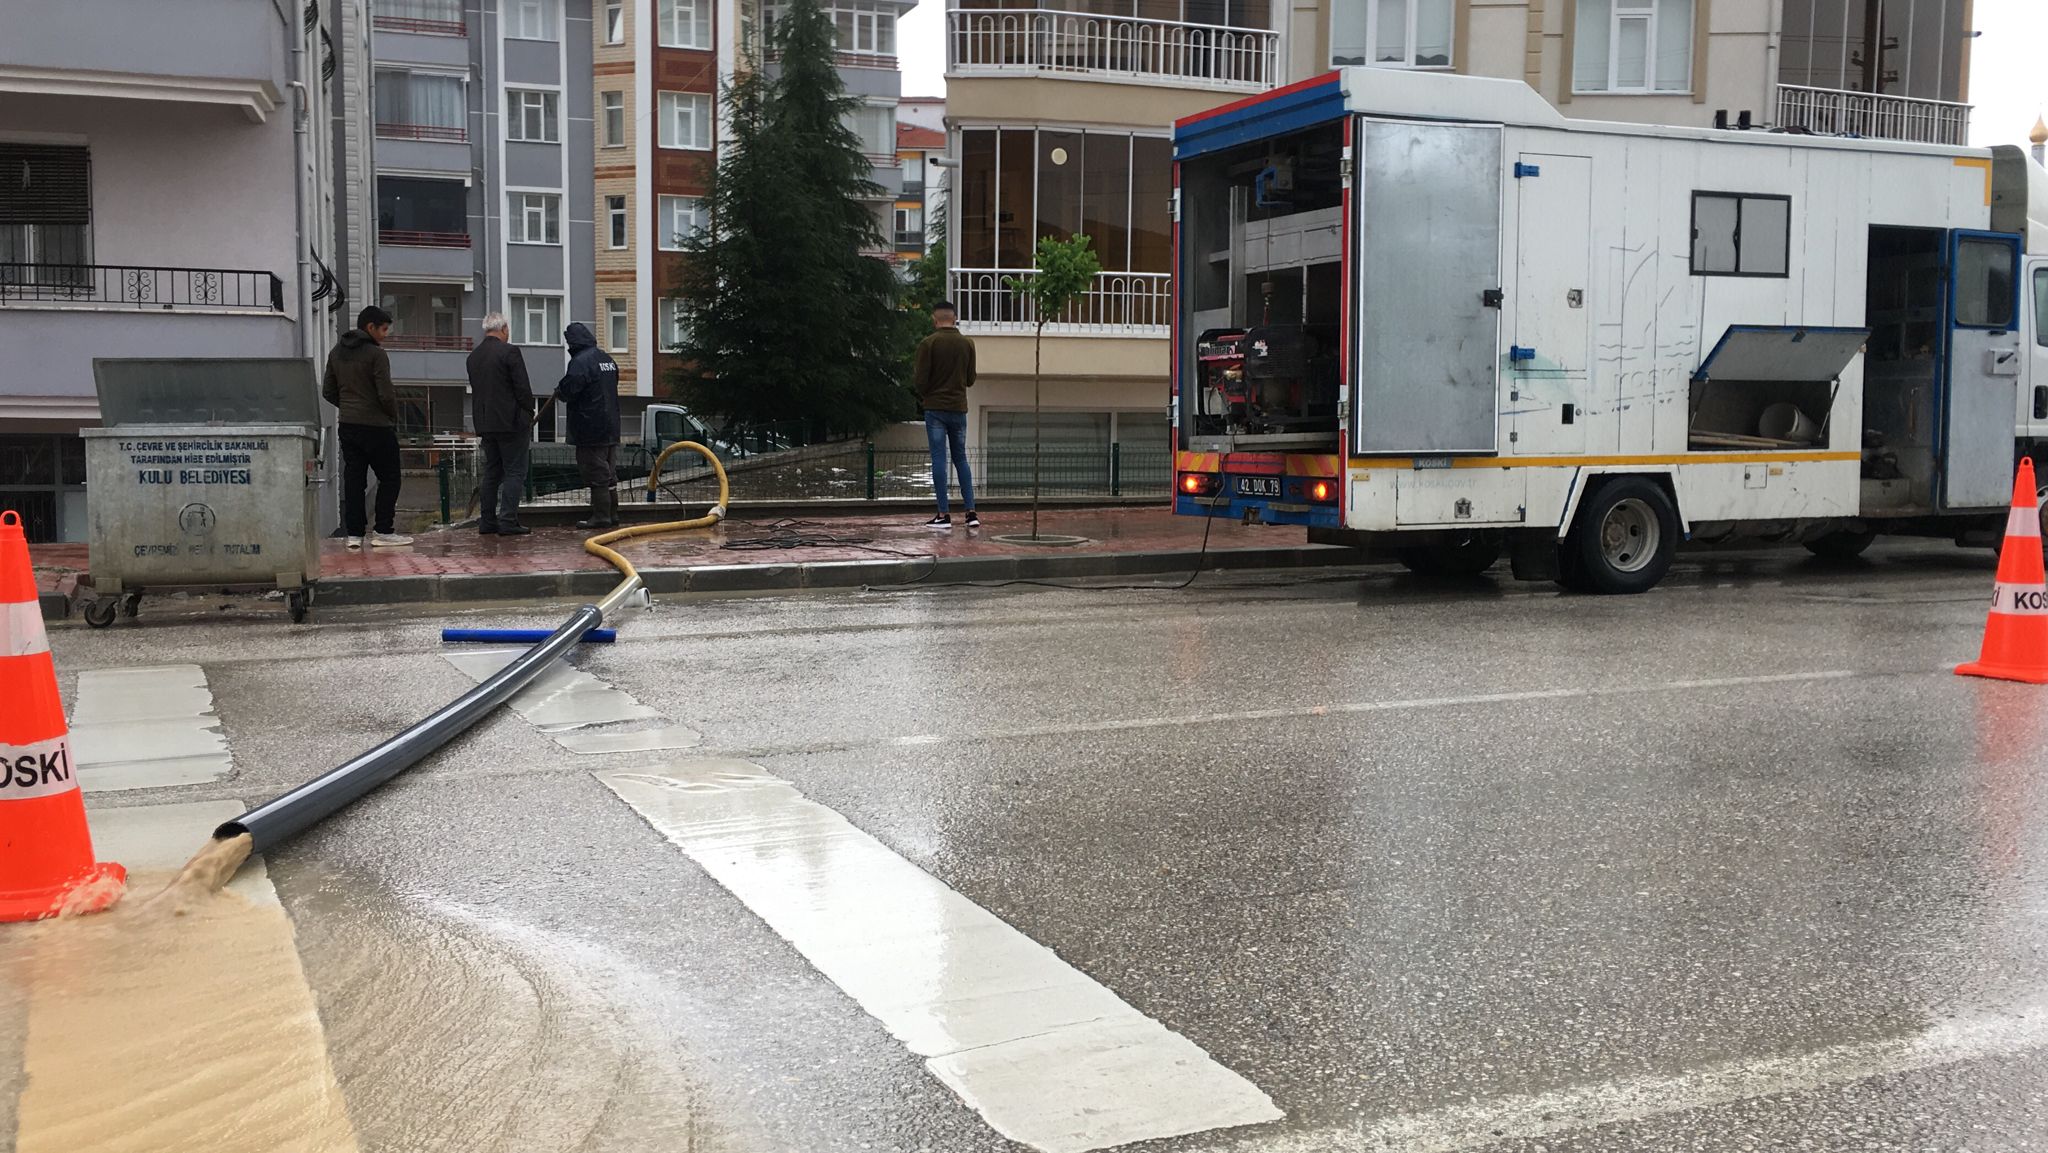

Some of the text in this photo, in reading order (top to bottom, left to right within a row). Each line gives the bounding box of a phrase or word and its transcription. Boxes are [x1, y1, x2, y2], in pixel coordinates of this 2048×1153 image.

[136, 442, 163, 454] ÇEVRE
[165, 442, 176, 451] VE
[177, 440, 223, 453] ŞEHİRCİLİK
[225, 440, 269, 451] BAKANLIĞI
[131, 455, 182, 464] TARAFINDAN
[205, 453, 252, 465] EDİLMİŞTİR
[139, 468, 252, 485] KULU BELEDİYESİ
[1241, 478, 1250, 491] 42
[1270, 479, 1279, 493] 79
